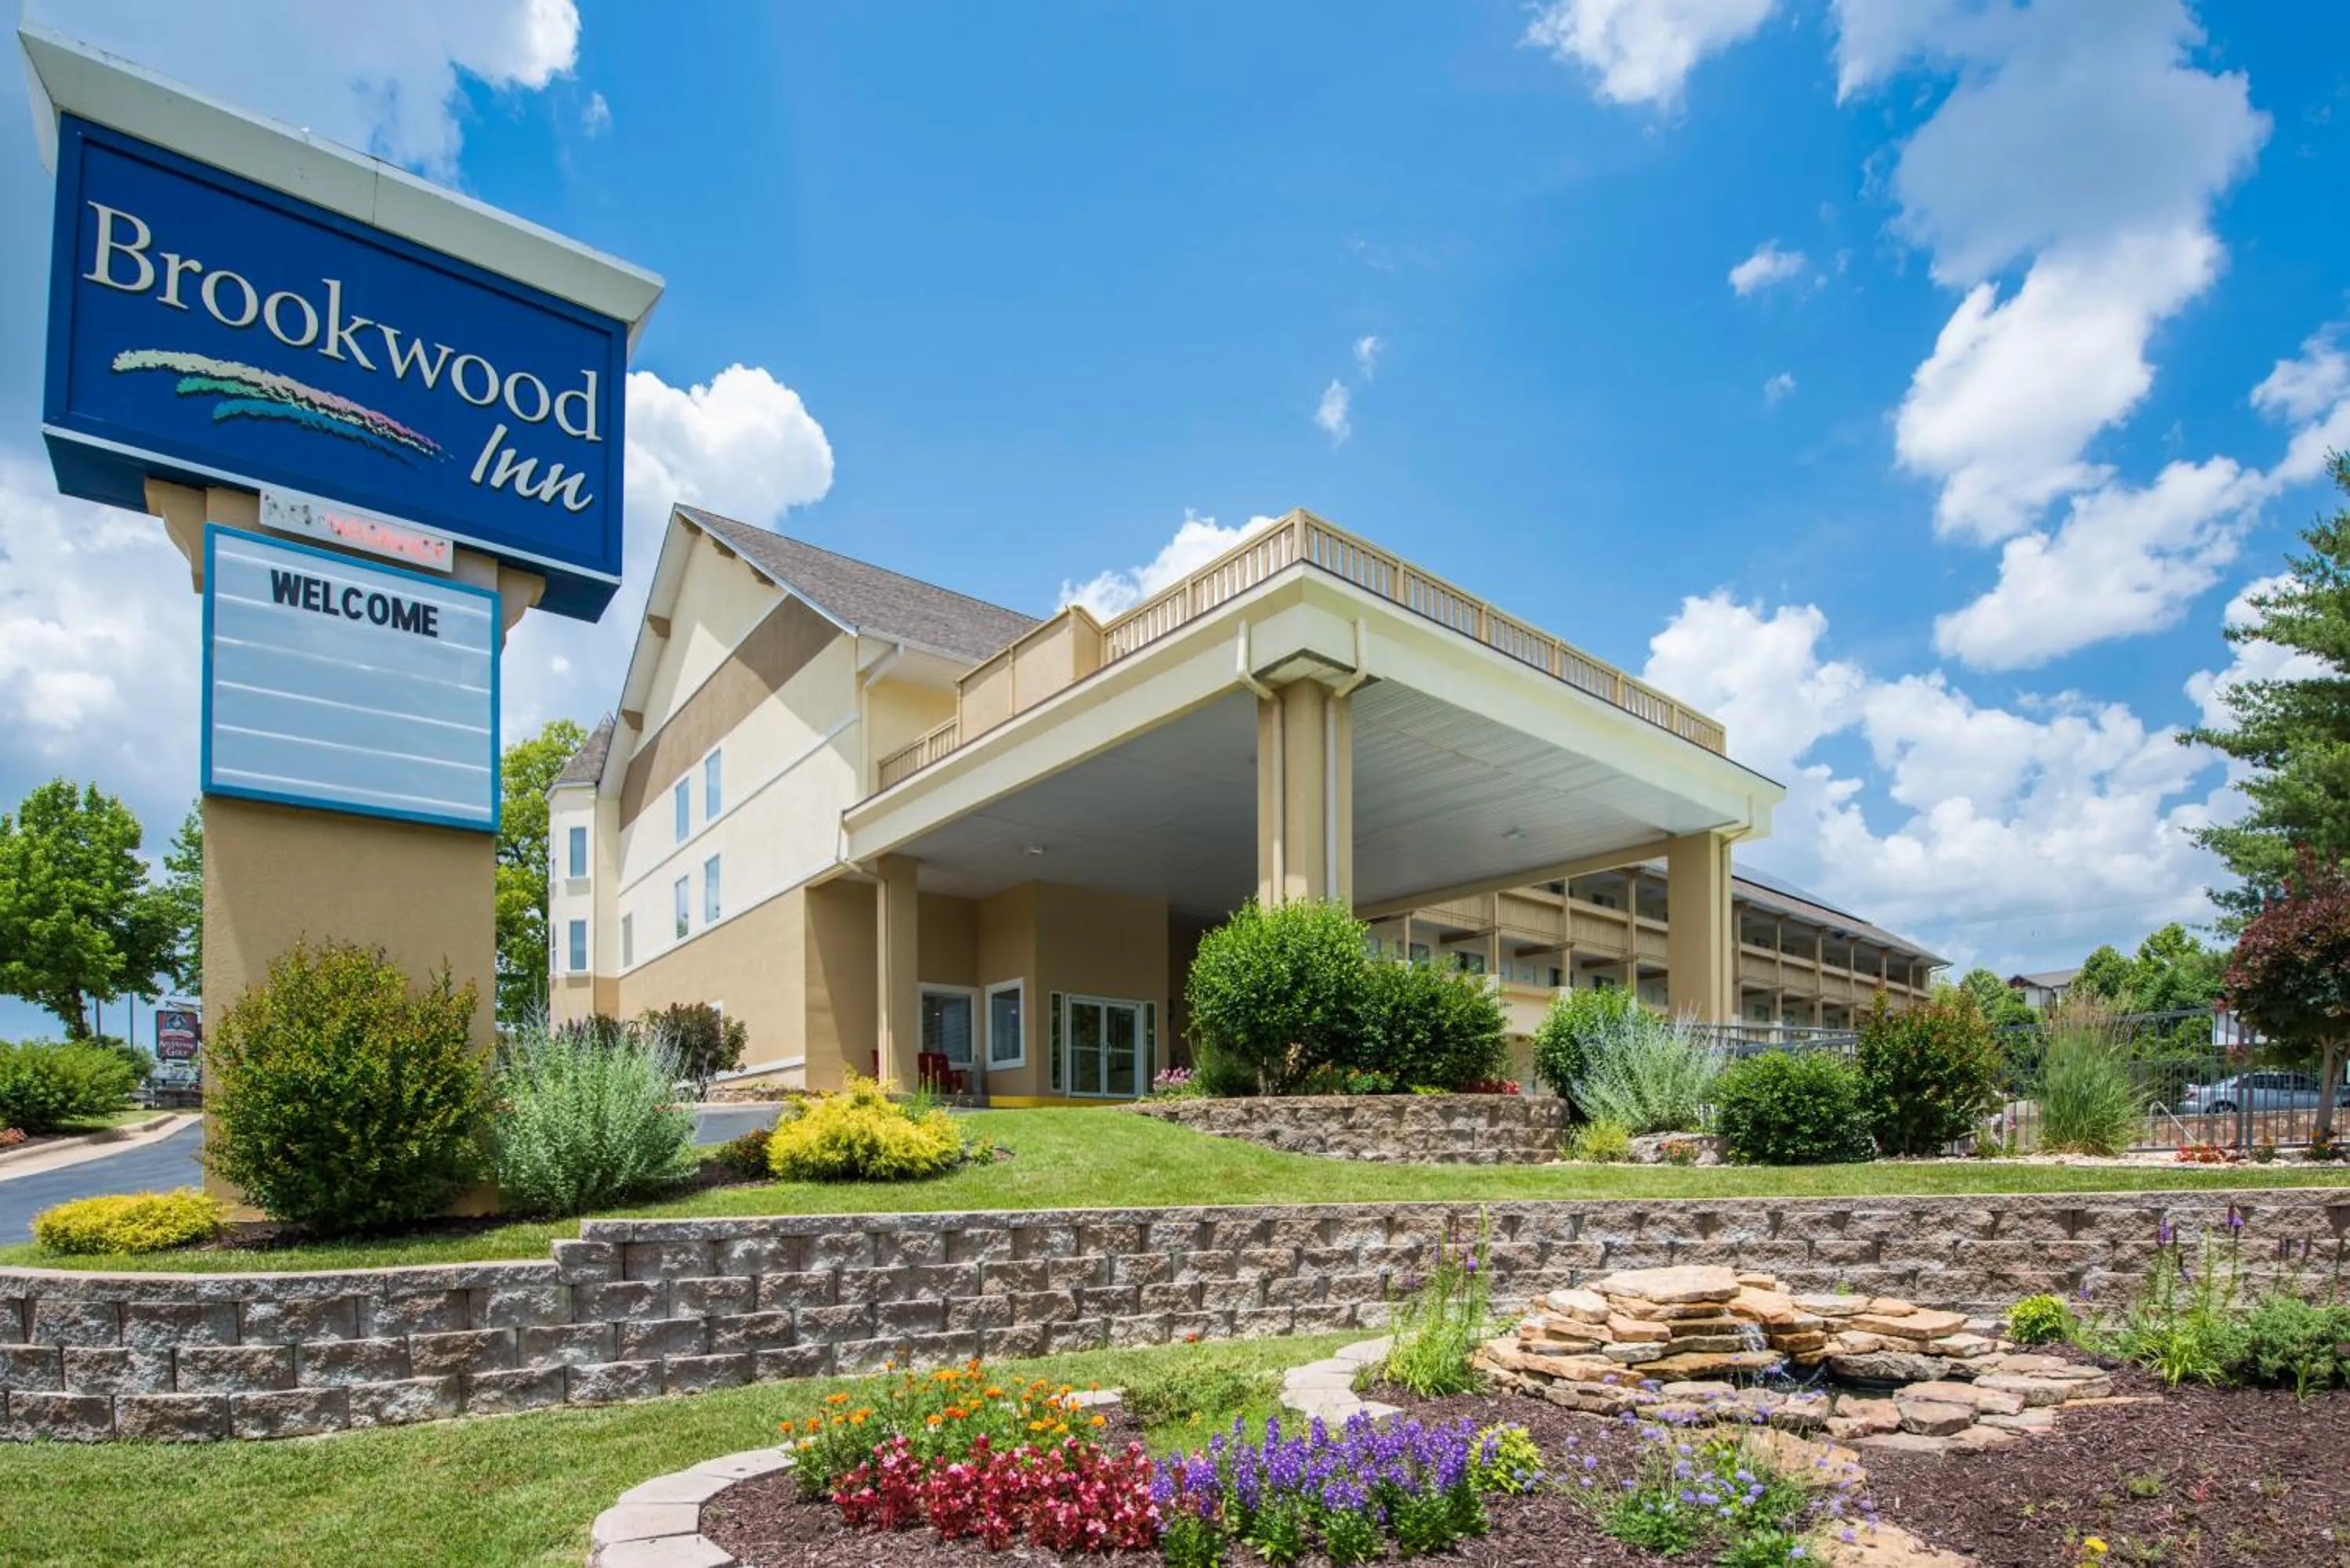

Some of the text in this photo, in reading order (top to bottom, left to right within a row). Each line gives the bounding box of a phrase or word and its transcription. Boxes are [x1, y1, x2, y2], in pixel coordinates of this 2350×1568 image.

[83, 201, 602, 440] Brookwood
[472, 425, 593, 511] Inn
[271, 569, 439, 638] WELCOME
